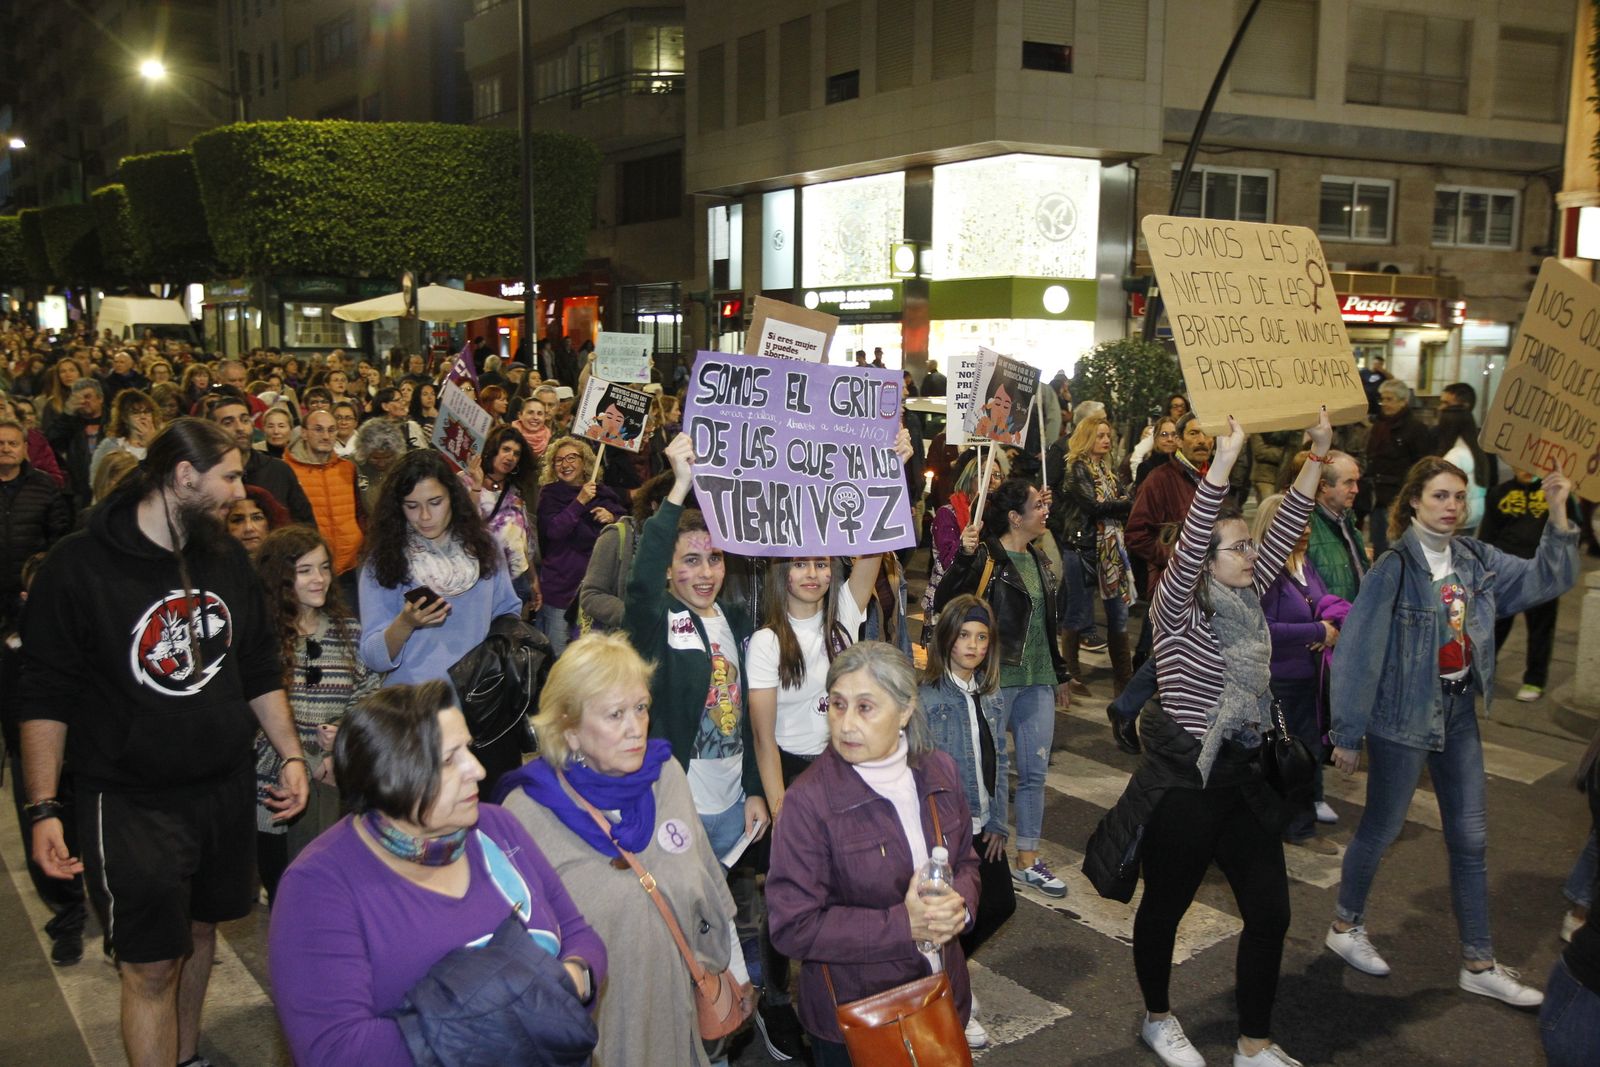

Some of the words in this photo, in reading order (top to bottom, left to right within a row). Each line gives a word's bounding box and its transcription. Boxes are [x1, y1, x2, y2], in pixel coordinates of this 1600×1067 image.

[1158, 222, 1244, 259] SOMOS
[1256, 229, 1299, 264] LAS
[1169, 271, 1242, 306] NIETAS
[1247, 275, 1274, 305] DE
[1278, 278, 1312, 308] LAS
[1342, 296, 1406, 316] Pasaje
[1536, 282, 1576, 329] NOS
[765, 341, 771, 350] y
[772, 342, 799, 355] puedes
[767, 331, 776, 340] Si
[777, 335, 794, 345] eres
[794, 340, 818, 351] mujer
[1177, 314, 1255, 349] BRUJAS
[1260, 316, 1290, 345] QUE
[1295, 319, 1343, 347] NUNCA
[694, 361, 772, 408] SOMOS
[785, 371, 812, 415] EL
[1196, 355, 1283, 391] PUDISTEIS
[1292, 358, 1358, 390] QUEMAR
[1562, 360, 1594, 397] QUE
[690, 415, 732, 468] DE
[739, 421, 779, 470] LAS
[786, 438, 839, 480] QUE
[842, 443, 868, 480] YA
[871, 446, 902, 480] NO
[1494, 423, 1514, 451] EL
[694, 468, 803, 547] TIENEN
[666, 823, 684, 847] 8
